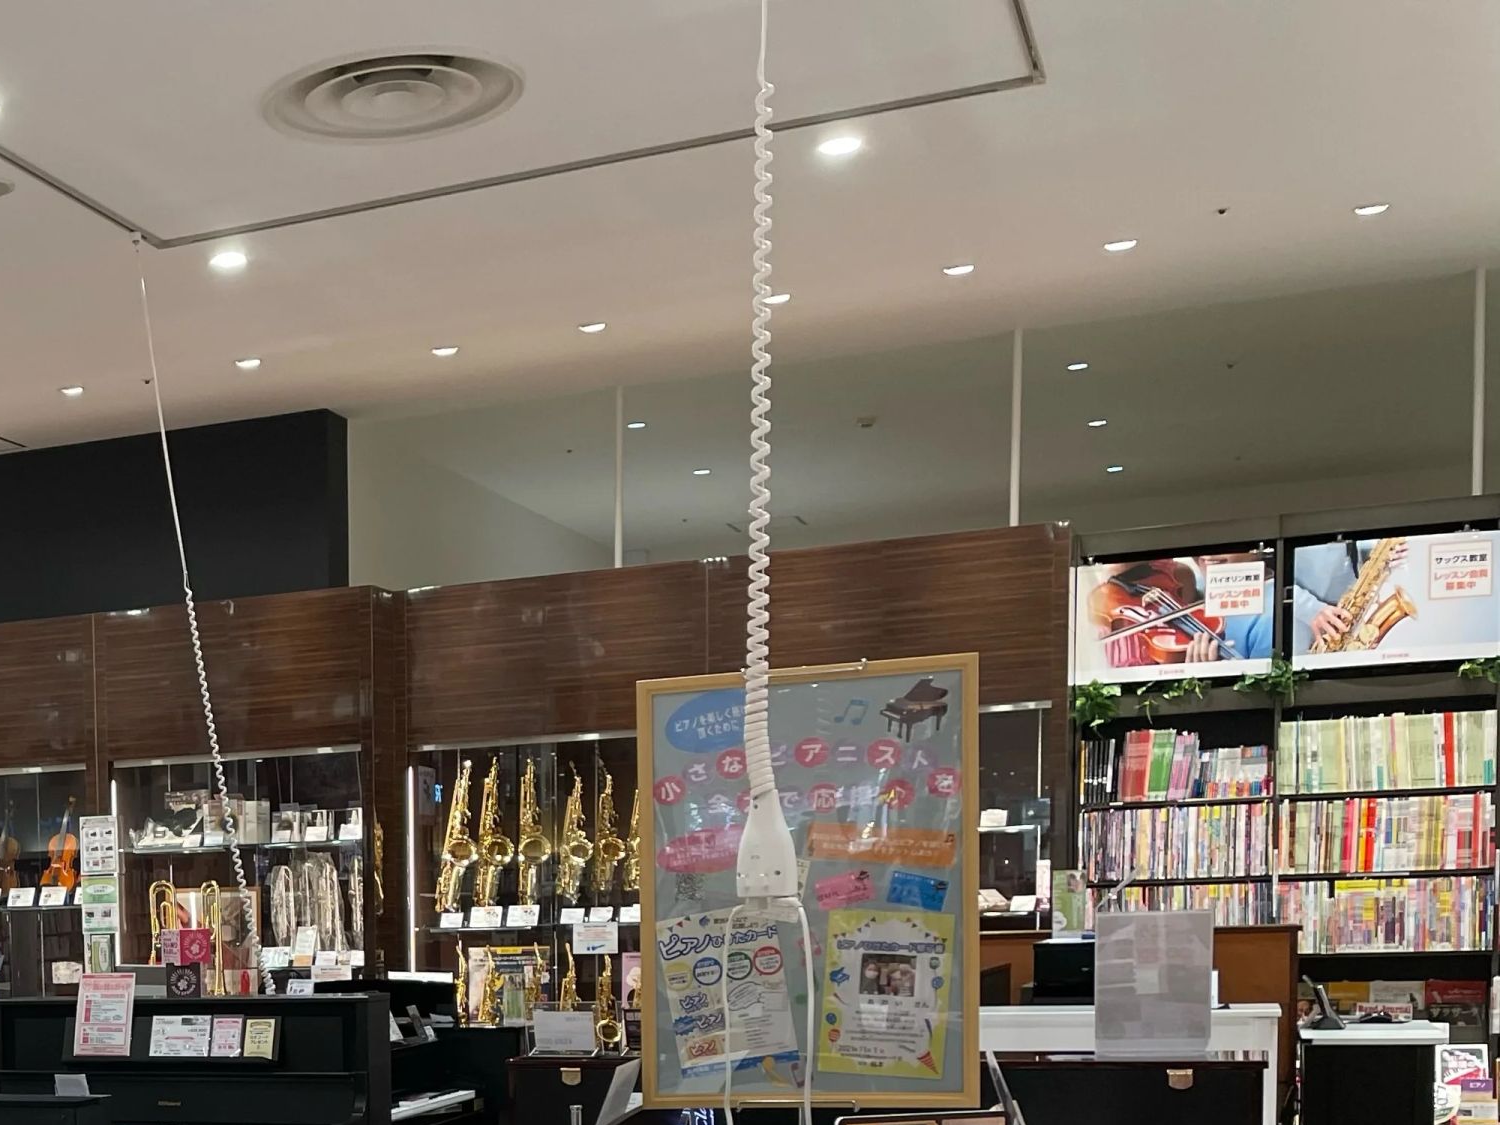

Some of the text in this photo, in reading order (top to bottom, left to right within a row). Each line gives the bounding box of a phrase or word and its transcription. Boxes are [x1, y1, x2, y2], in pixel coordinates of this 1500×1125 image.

[1434, 552, 1488, 565] サックス教室
[1209, 573, 1261, 585] バイオリン教室
[1433, 567, 1488, 581] レッスン会員
[1445, 579, 1477, 591] 募集中
[1208, 587, 1260, 600] レッスン会員
[1219, 599, 1250, 610] 募集中
